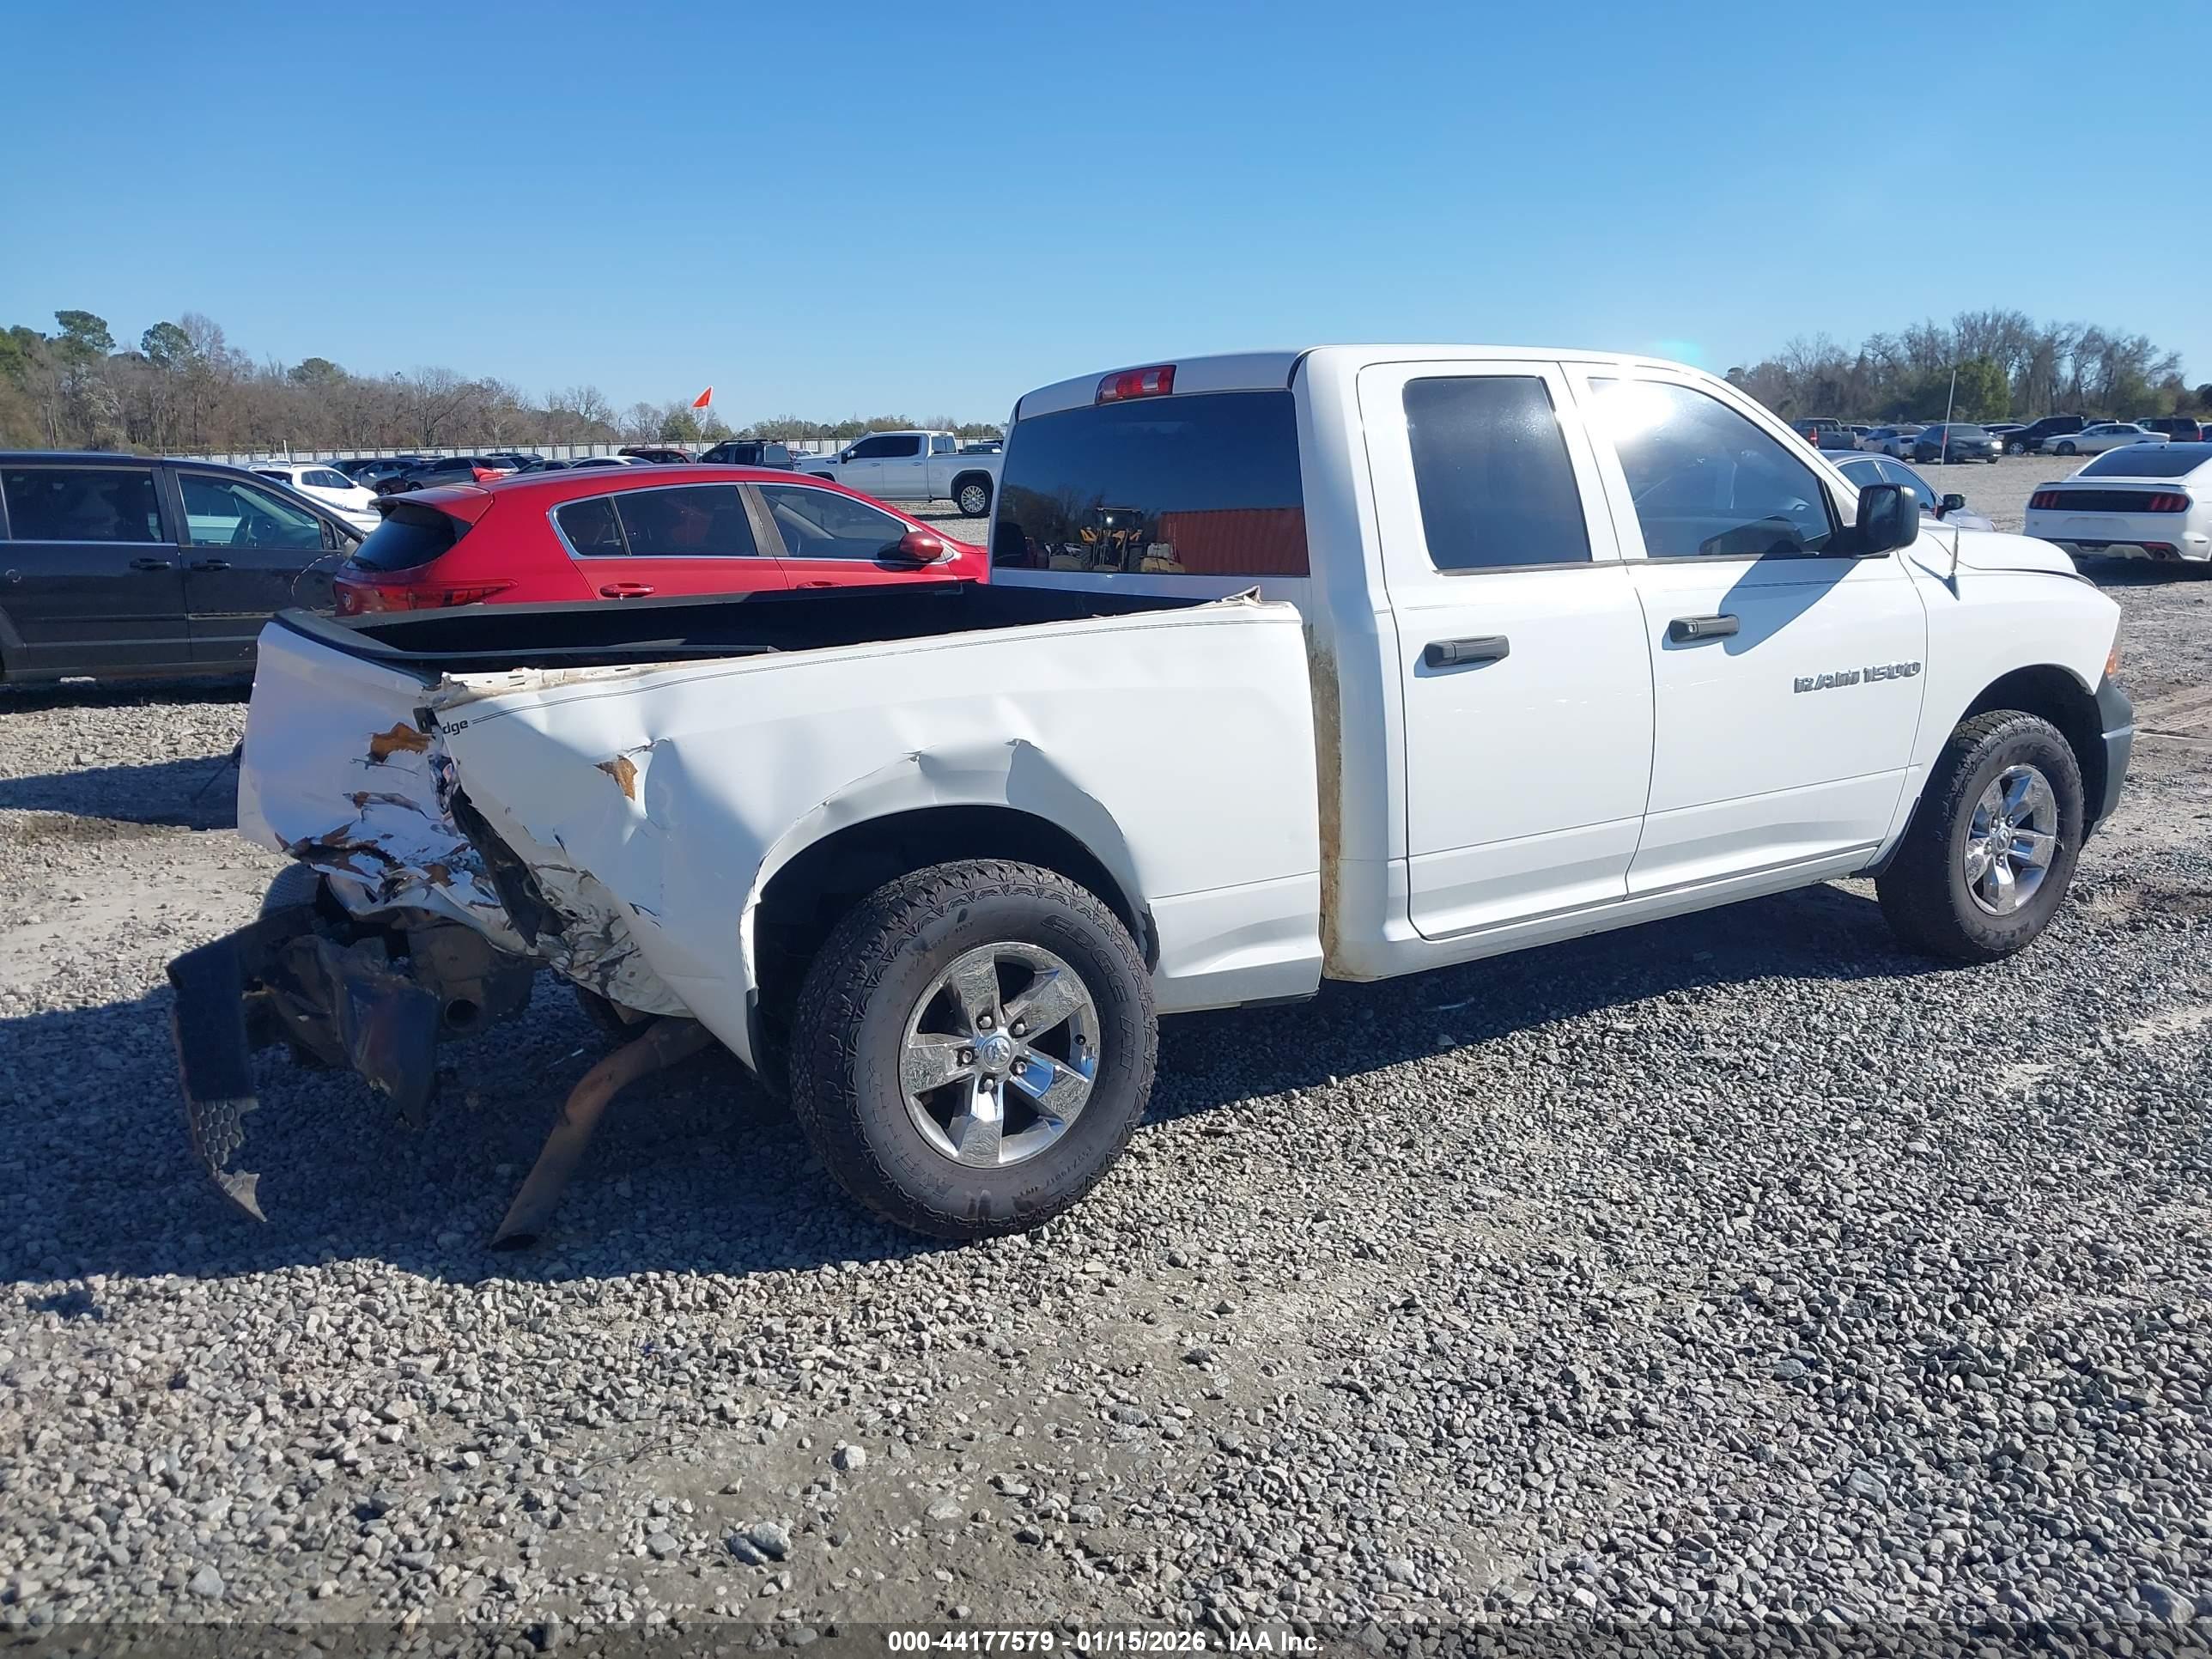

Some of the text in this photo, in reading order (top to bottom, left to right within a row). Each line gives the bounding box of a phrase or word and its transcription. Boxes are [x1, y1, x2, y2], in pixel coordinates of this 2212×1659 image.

[1794, 661, 1922, 694] RAM 1500
[441, 720, 469, 736] dge
[1041, 913, 1129, 1003] EDGE
